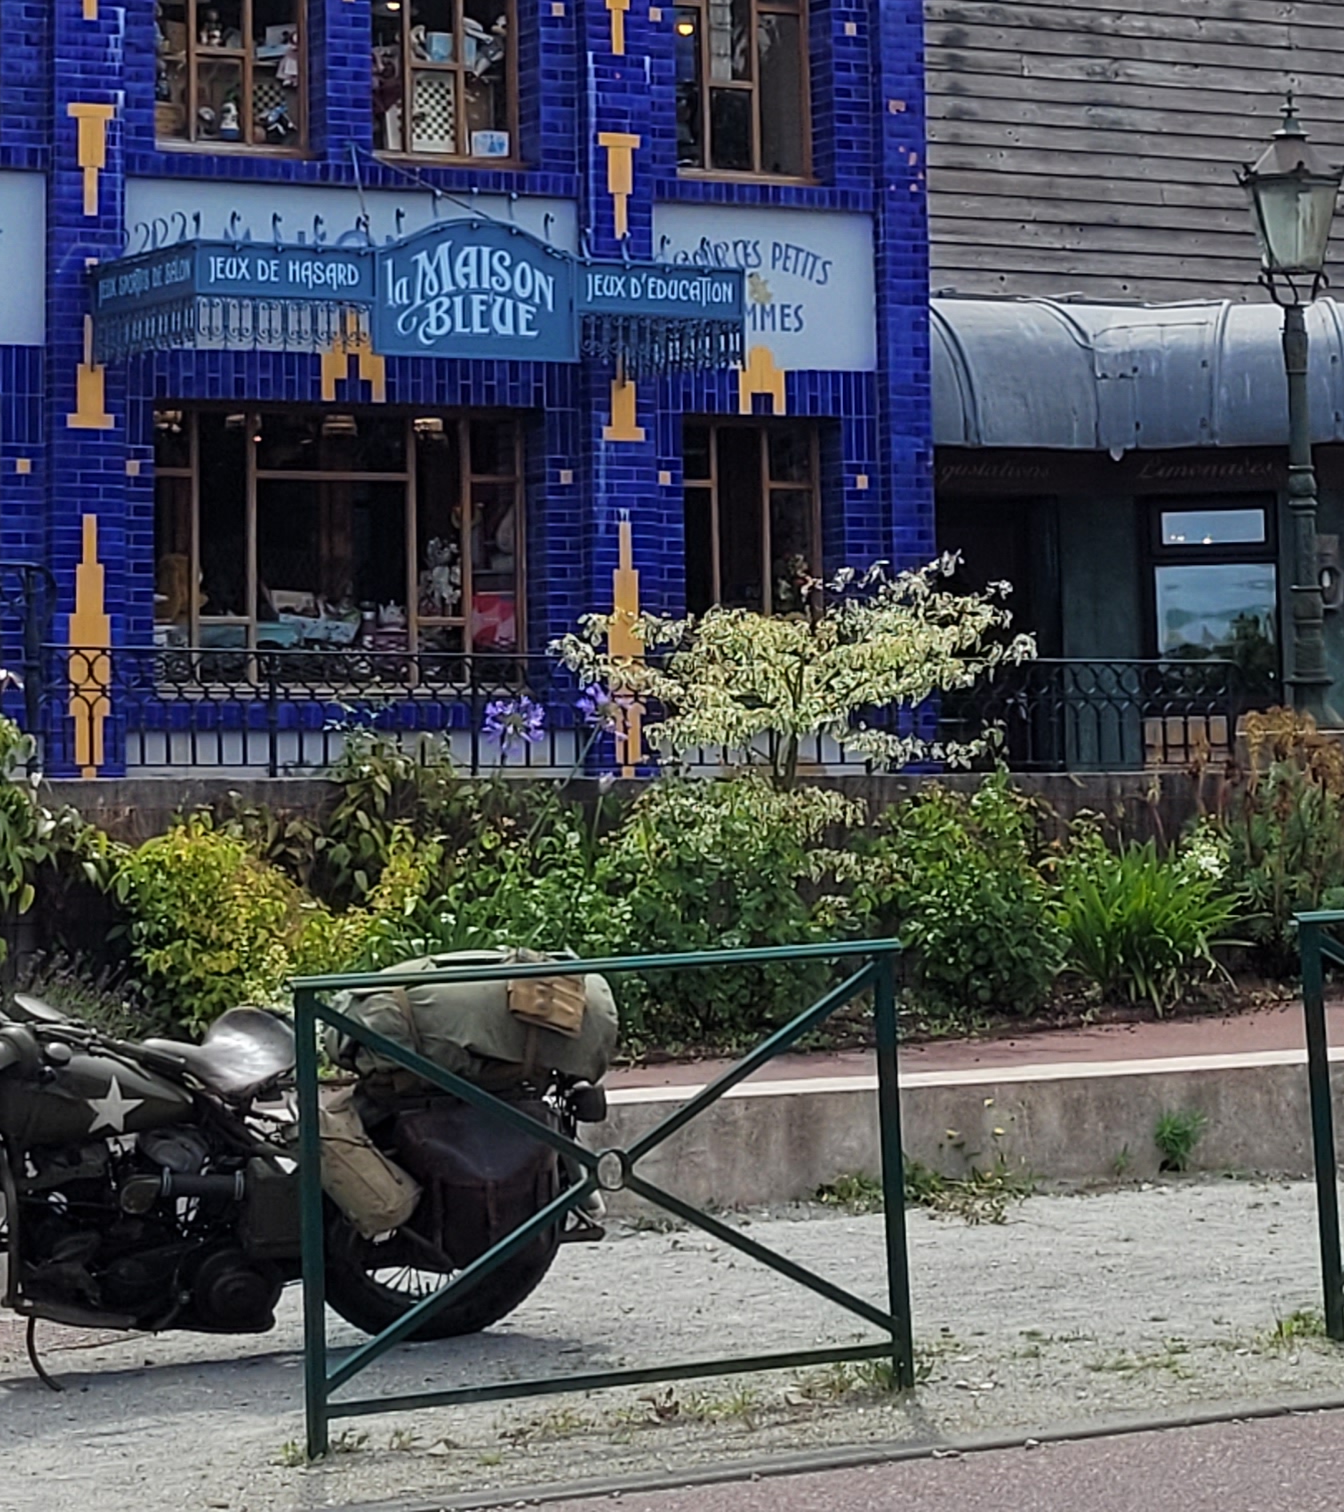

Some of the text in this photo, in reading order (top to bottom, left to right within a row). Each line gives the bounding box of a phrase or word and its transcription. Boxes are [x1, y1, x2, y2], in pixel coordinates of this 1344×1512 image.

[208, 256, 360, 291] JEUX DE HASARD
[404, 240, 555, 320] MAISON
[771, 241, 833, 285] PETITS
[586, 273, 734, 307] JEUX D'EDUCATION
[419, 293, 540, 345] BLEUE
